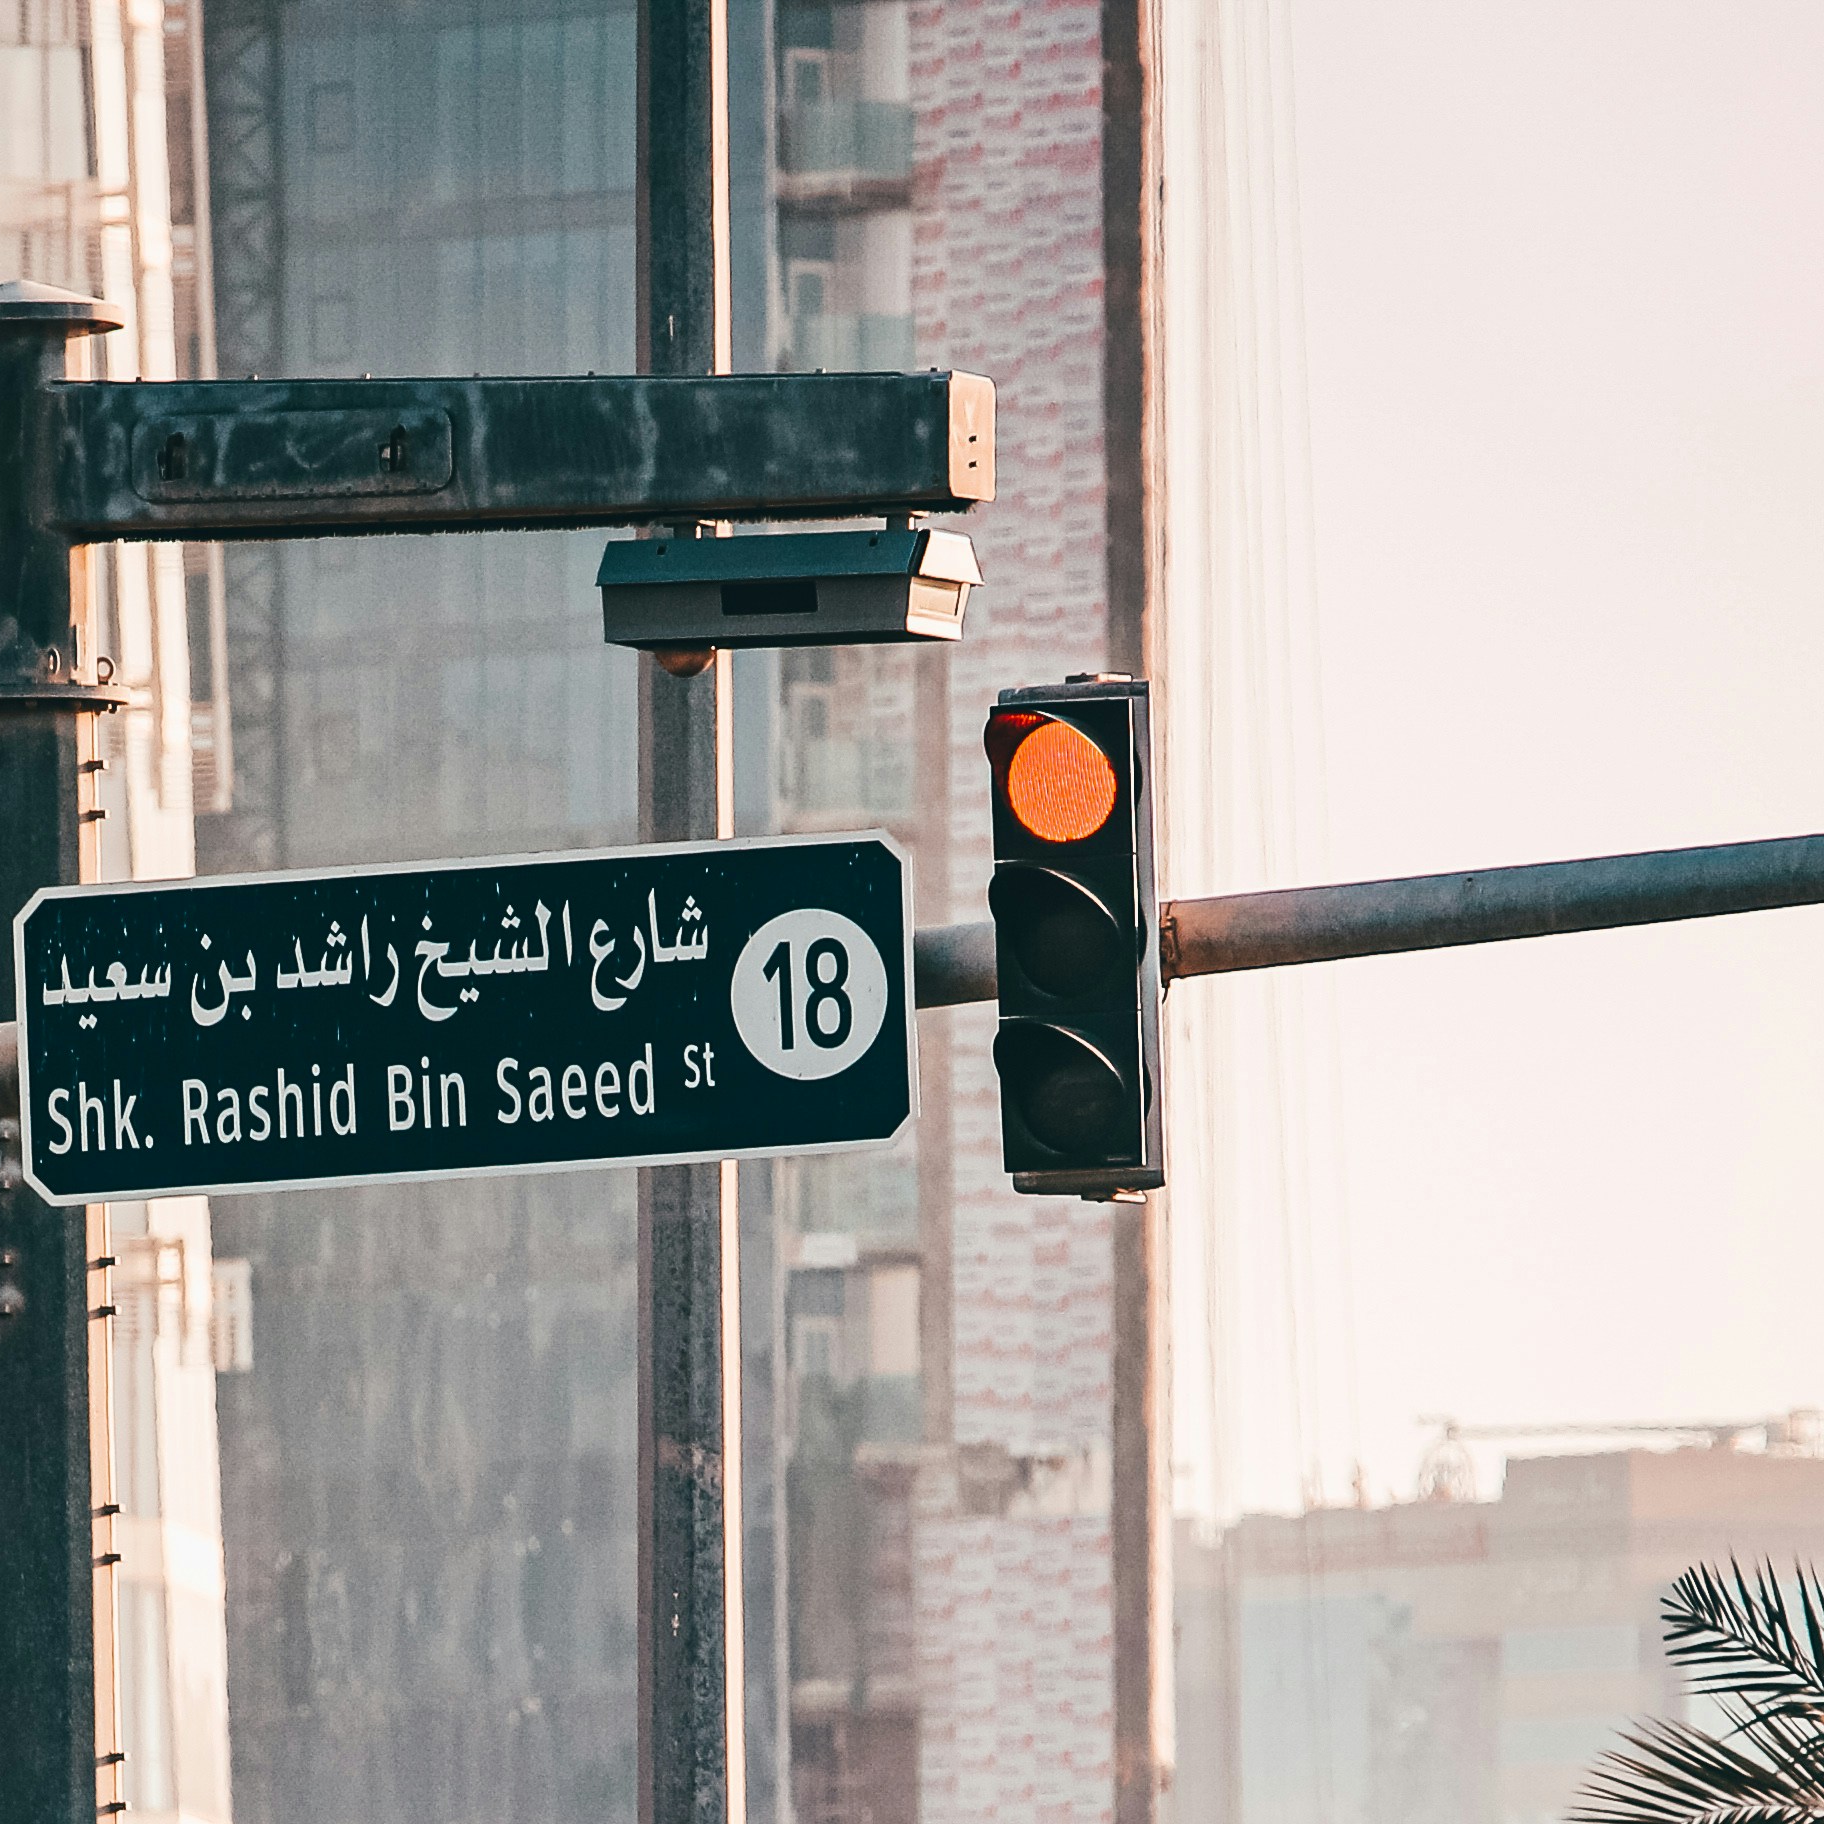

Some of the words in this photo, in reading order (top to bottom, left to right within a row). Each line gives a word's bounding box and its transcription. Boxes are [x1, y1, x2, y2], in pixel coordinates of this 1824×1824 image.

[41, 950, 172, 1031] سعيد
[190, 933, 258, 1027] بن
[276, 913, 401, 1007] راشد
[414, 898, 574, 1023] الشيخ
[589, 887, 710, 1012] شارع
[761, 936, 853, 1051] 18
[46, 1077, 155, 1155] Shk.
[182, 1062, 357, 1146] Rashid
[387, 1055, 467, 1132] Bin
[495, 1042, 656, 1125] Saeed
[683, 1042, 717, 1090] St
